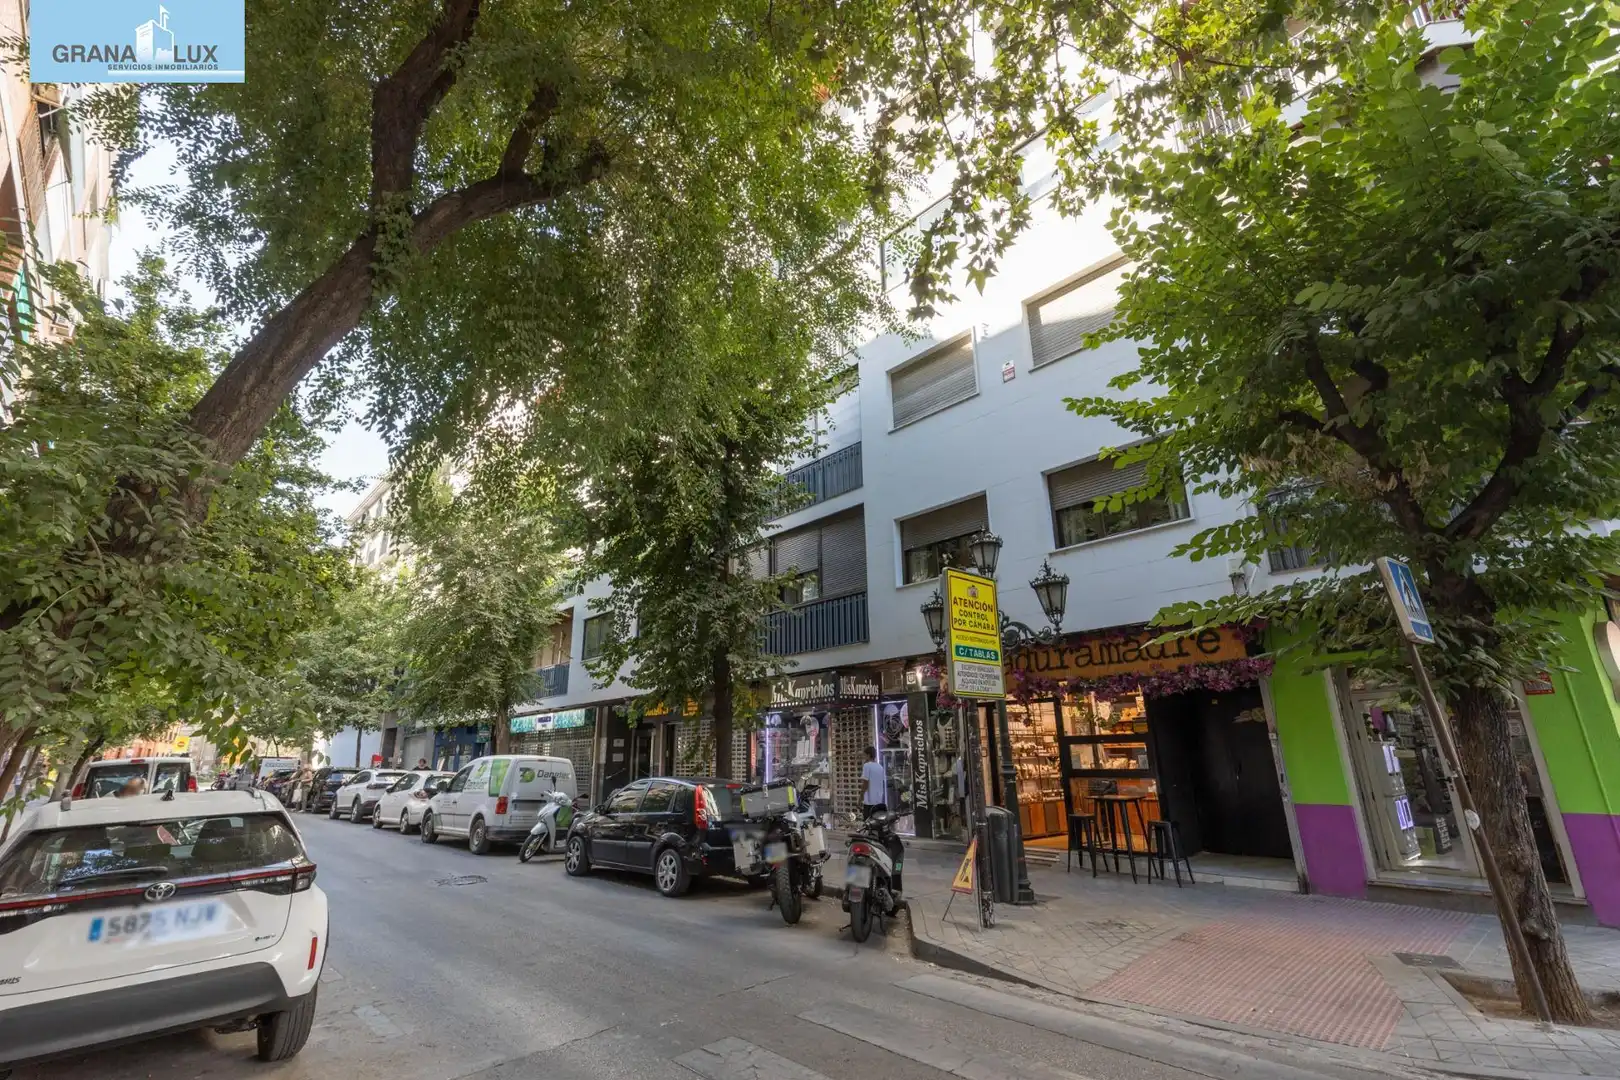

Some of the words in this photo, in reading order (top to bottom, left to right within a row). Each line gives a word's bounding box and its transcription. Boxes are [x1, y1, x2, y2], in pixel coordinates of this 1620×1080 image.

[953, 596, 994, 613] ATENCIÓN
[954, 617, 967, 627] POR
[958, 609, 989, 622] CONTROL
[969, 649, 996, 660] TABLAS
[914, 720, 928, 810] MisKaprichos
